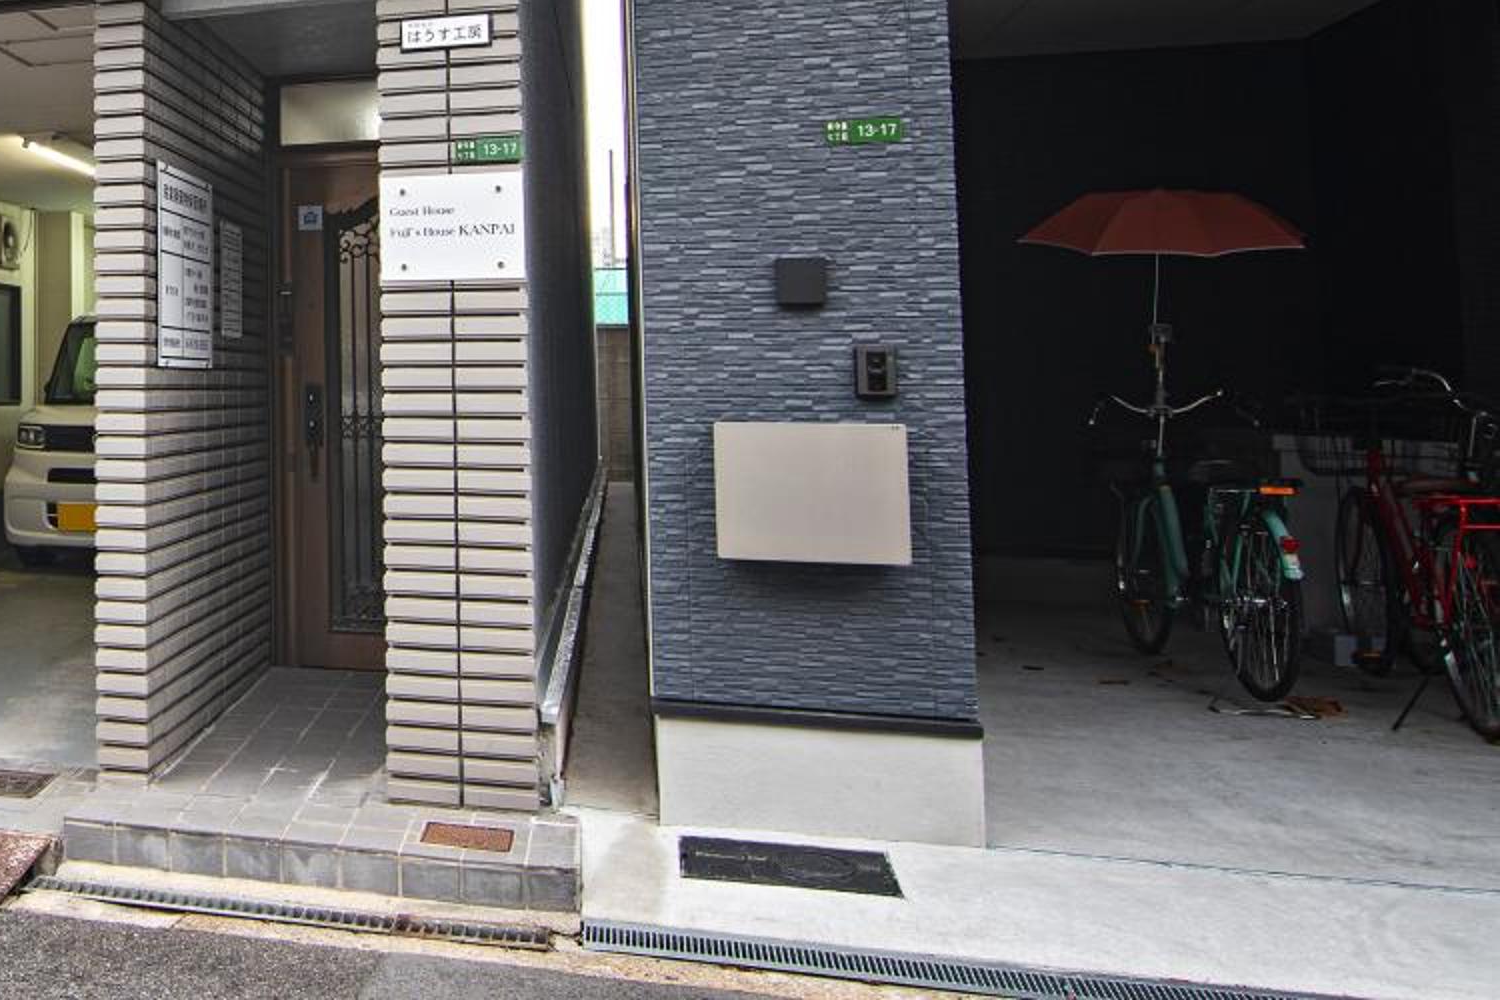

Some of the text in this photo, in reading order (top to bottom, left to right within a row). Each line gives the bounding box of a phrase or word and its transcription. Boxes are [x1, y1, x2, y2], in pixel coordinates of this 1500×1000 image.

[407, 24, 482, 44] はうす工房
[857, 122, 898, 137] 13-17
[484, 142, 517, 156] 13-17
[460, 223, 516, 237] KANPAI
